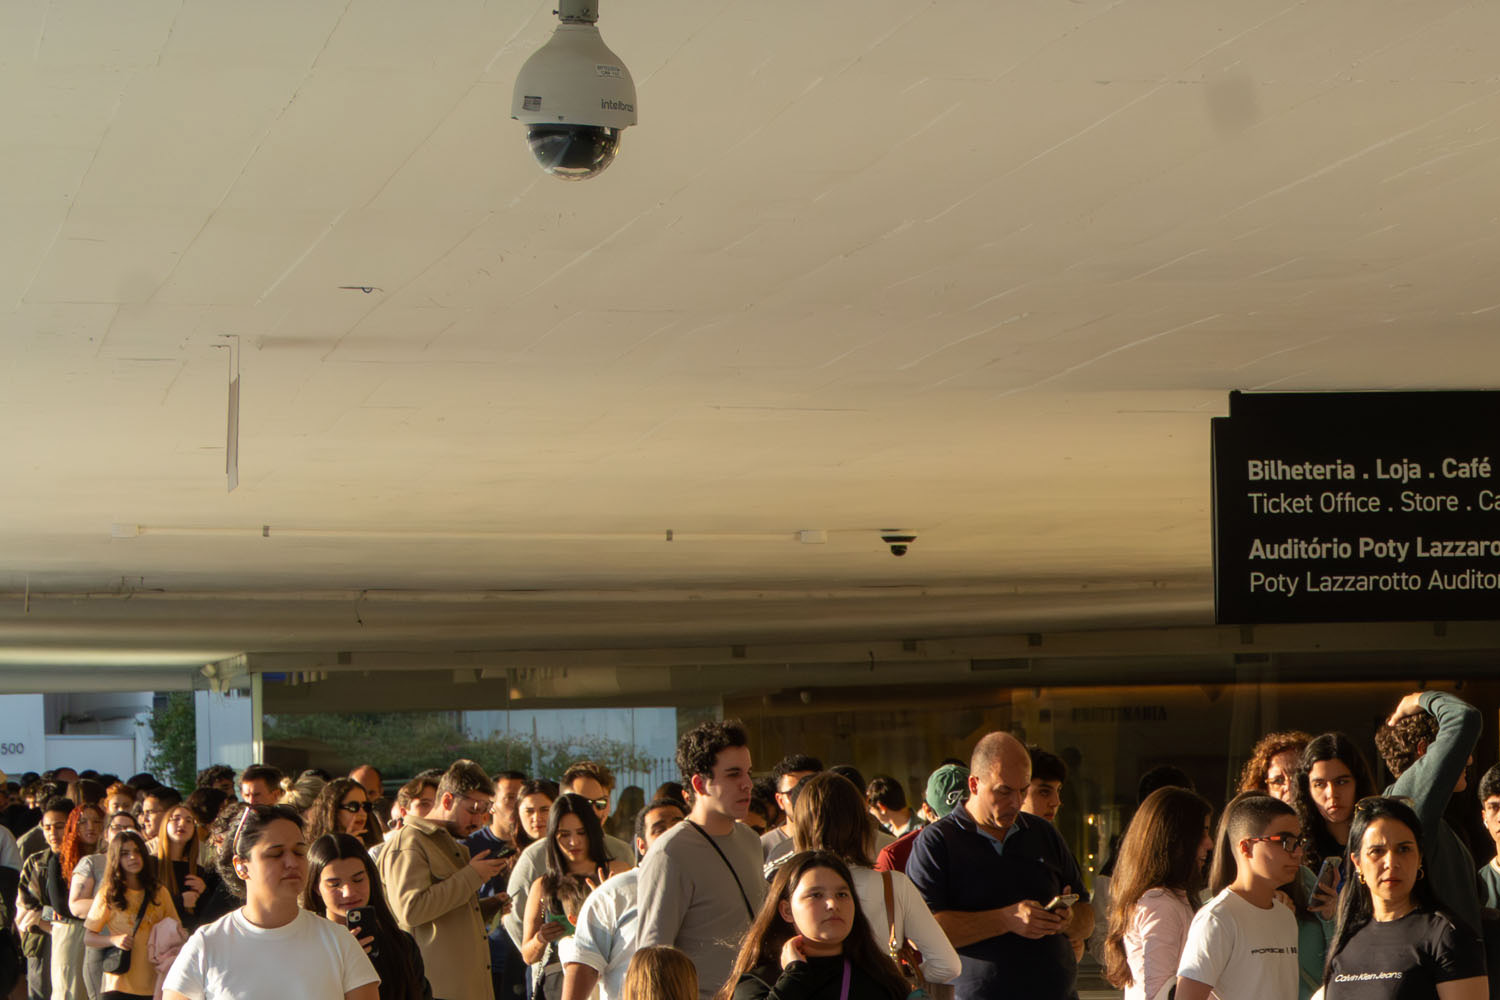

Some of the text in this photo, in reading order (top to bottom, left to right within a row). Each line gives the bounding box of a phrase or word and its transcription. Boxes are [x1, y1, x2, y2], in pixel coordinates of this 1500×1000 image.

[1248, 460, 1355, 480] Bilheteria
[1376, 458, 1421, 484] Loja
[1442, 457, 1491, 478] Café
[1248, 493, 1312, 514] Ticket
[1320, 492, 1380, 512] Office
[1400, 491, 1458, 512] Store
[1249, 537, 1351, 559] Auditório
[1359, 537, 1410, 563] Poty
[1250, 572, 1299, 597] Poty
[1306, 571, 1422, 592] Lazzarotto
[1376, 971, 1403, 980] Jeans
